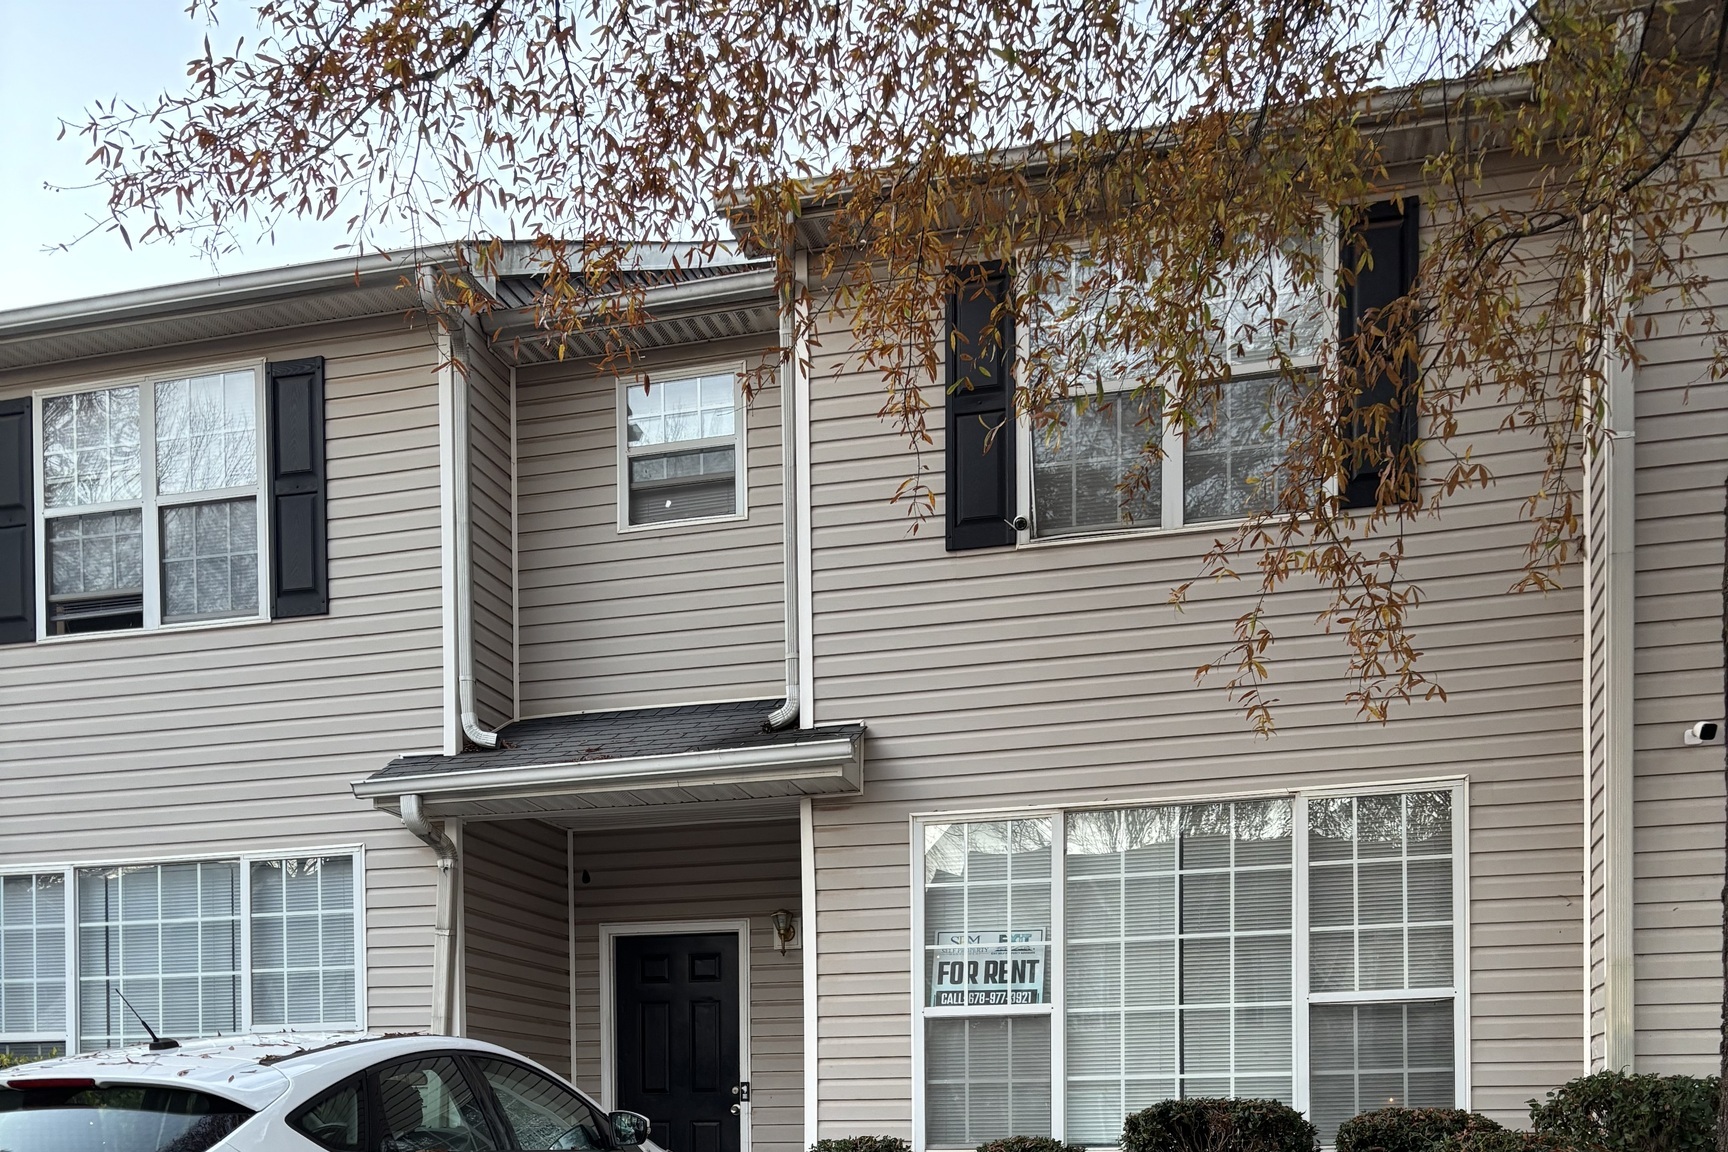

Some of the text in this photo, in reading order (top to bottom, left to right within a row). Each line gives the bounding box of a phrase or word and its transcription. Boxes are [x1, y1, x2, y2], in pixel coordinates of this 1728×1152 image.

[937, 959, 1040, 985] FOR RENT
[968, 991, 1032, 1004] 678-977-3921
